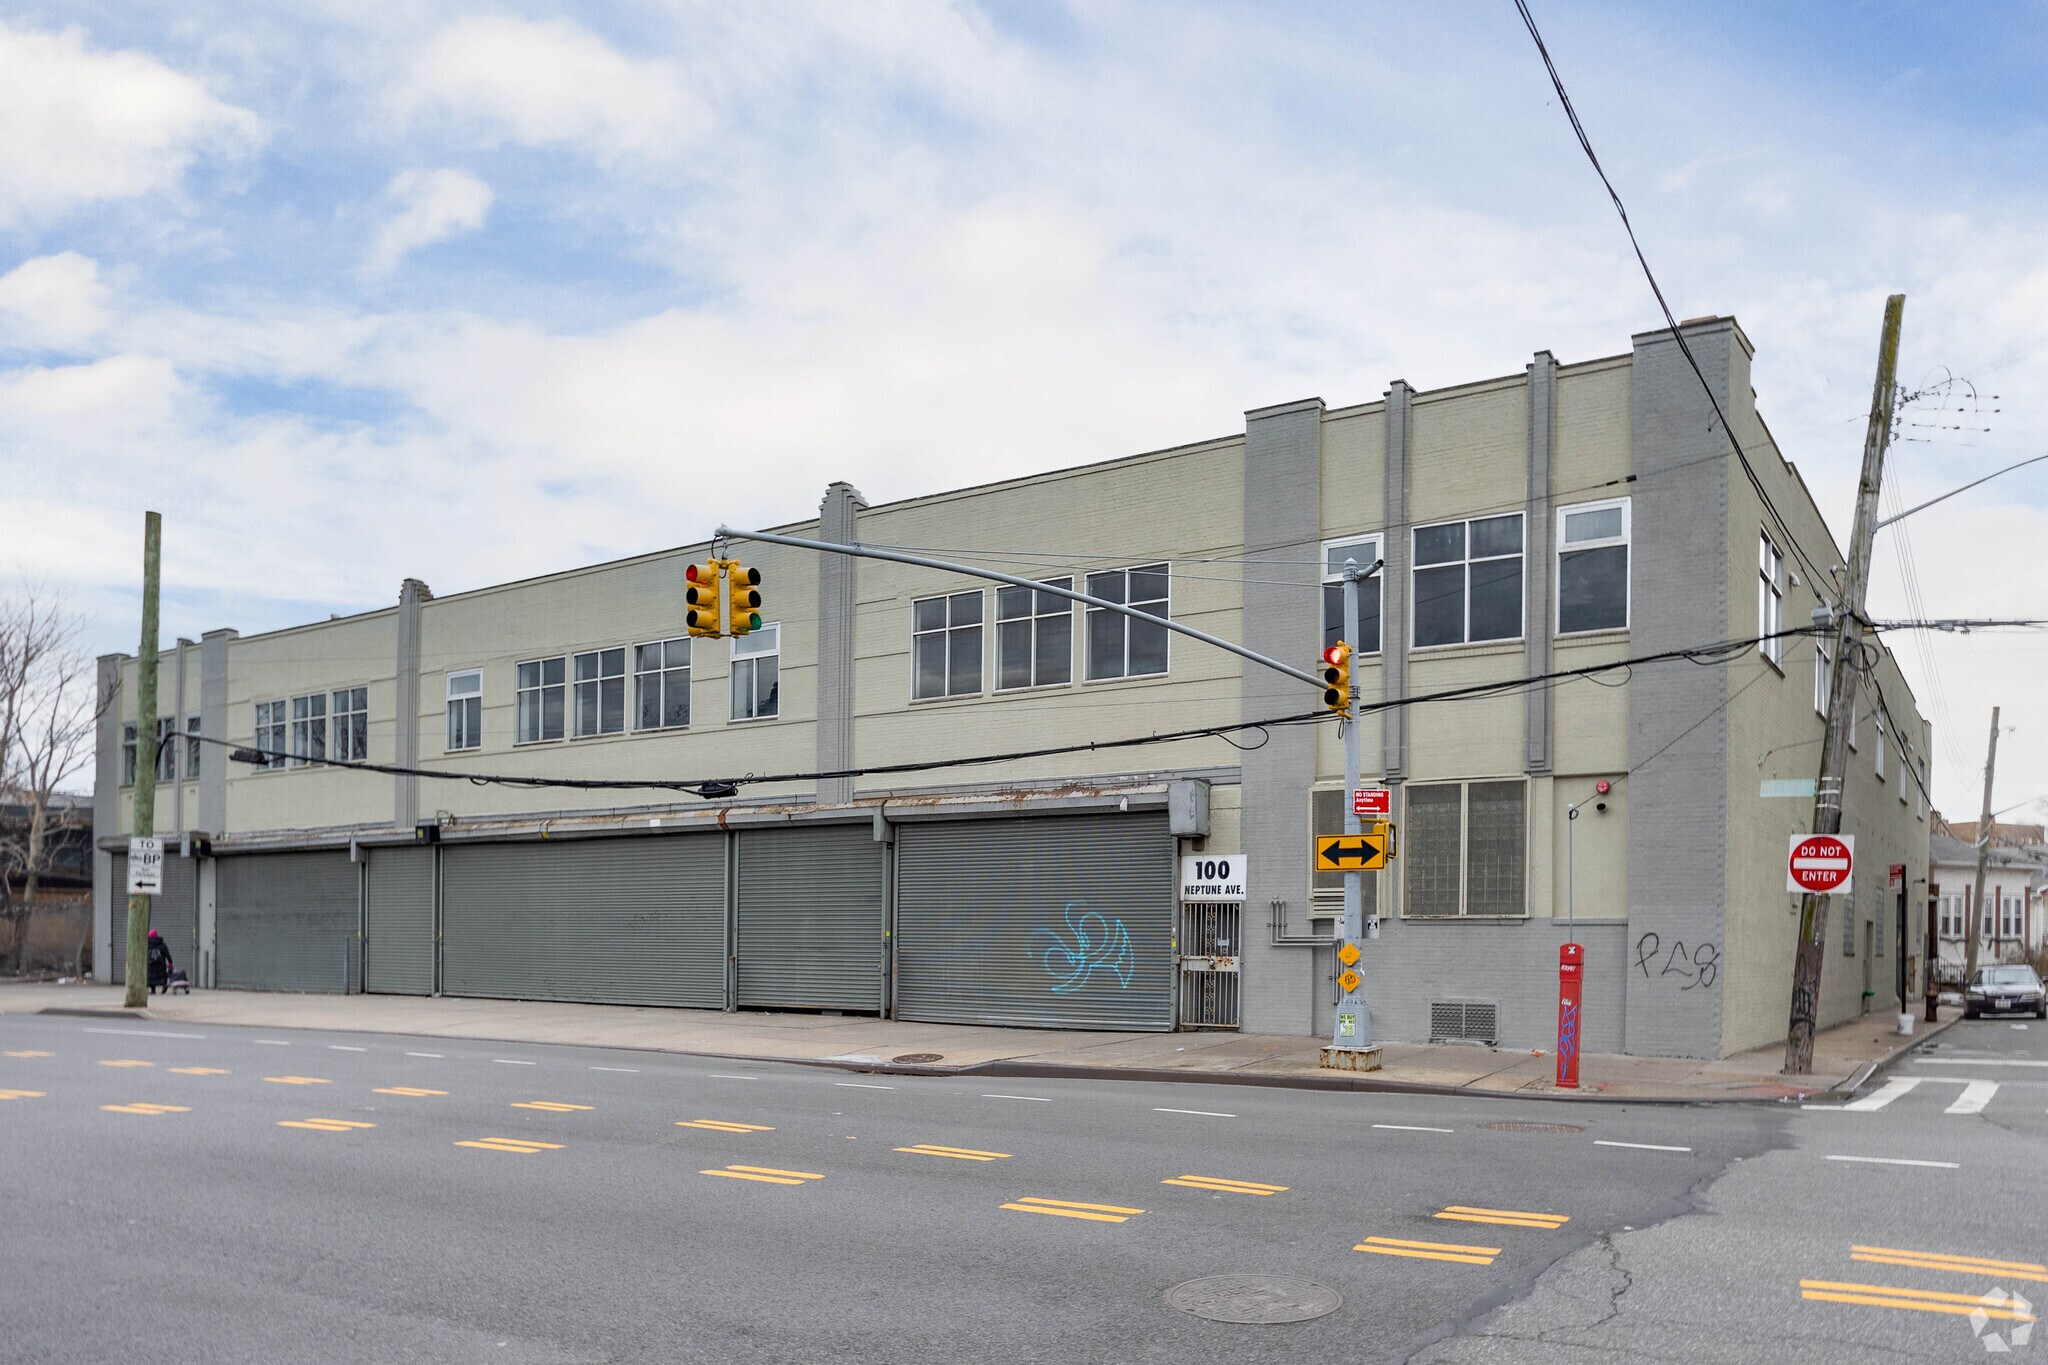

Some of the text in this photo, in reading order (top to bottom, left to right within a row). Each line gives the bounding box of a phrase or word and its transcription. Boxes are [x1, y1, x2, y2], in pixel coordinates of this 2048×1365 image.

[140, 840, 154, 848] TO
[1801, 846, 1841, 857] DO NOT
[144, 854, 160, 864] BP
[1195, 860, 1230, 880] 100
[1802, 871, 1837, 882] ENTER
[1184, 884, 1244, 895] NEPTUNE AVE.
